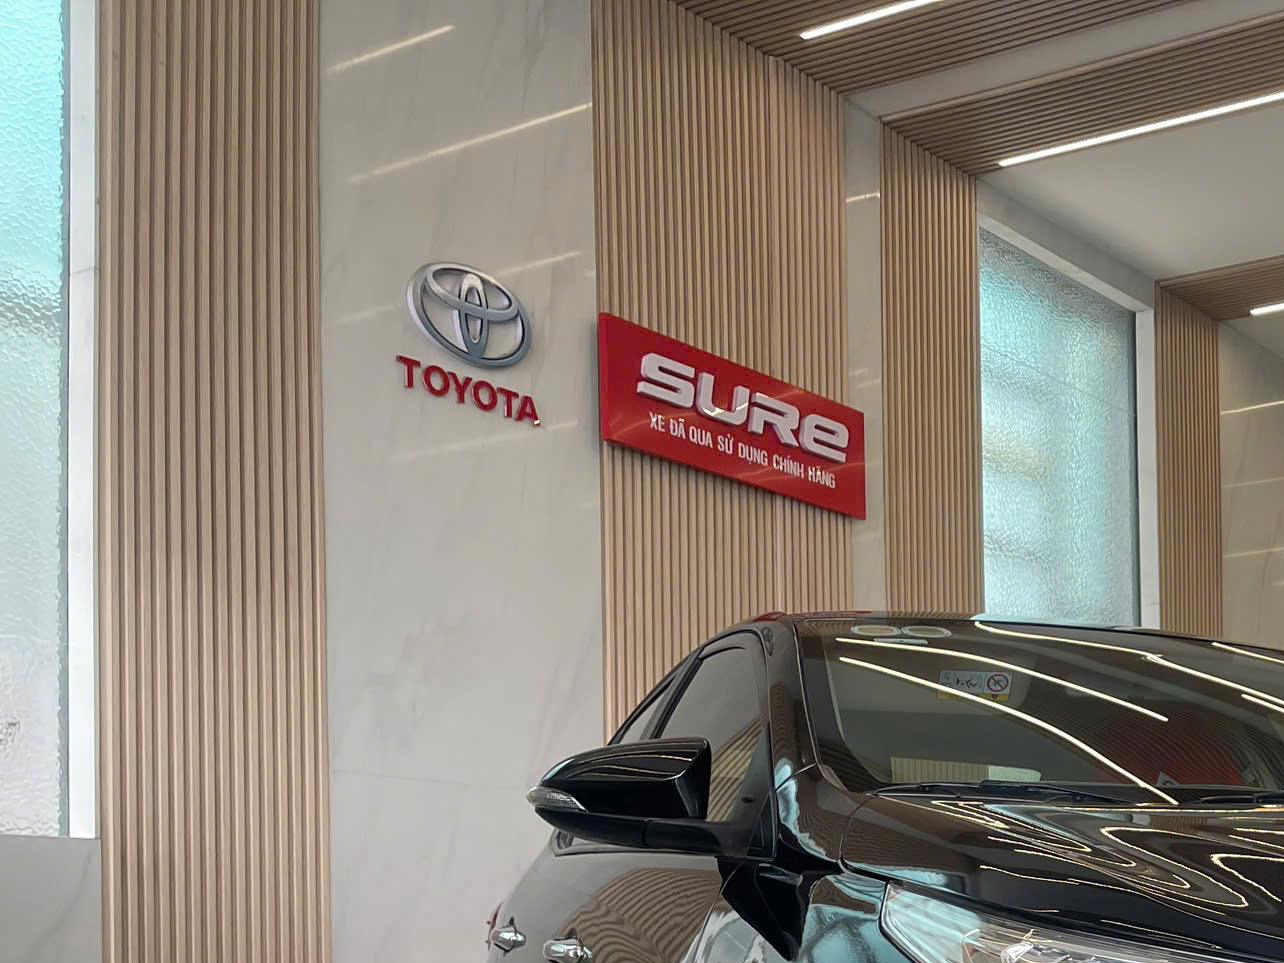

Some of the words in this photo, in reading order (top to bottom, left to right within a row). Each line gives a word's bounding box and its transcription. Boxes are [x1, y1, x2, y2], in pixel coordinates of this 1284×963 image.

[396, 355, 541, 427] TOYOTA
[649, 411, 666, 432] XE
[669, 418, 686, 440] ĐÃ
[689, 426, 713, 449] QUA
[717, 433, 735, 455] SỬ
[738, 443, 768, 467] DỤNG
[772, 454, 805, 479] CHÍNH
[808, 465, 836, 489] HÃNG
